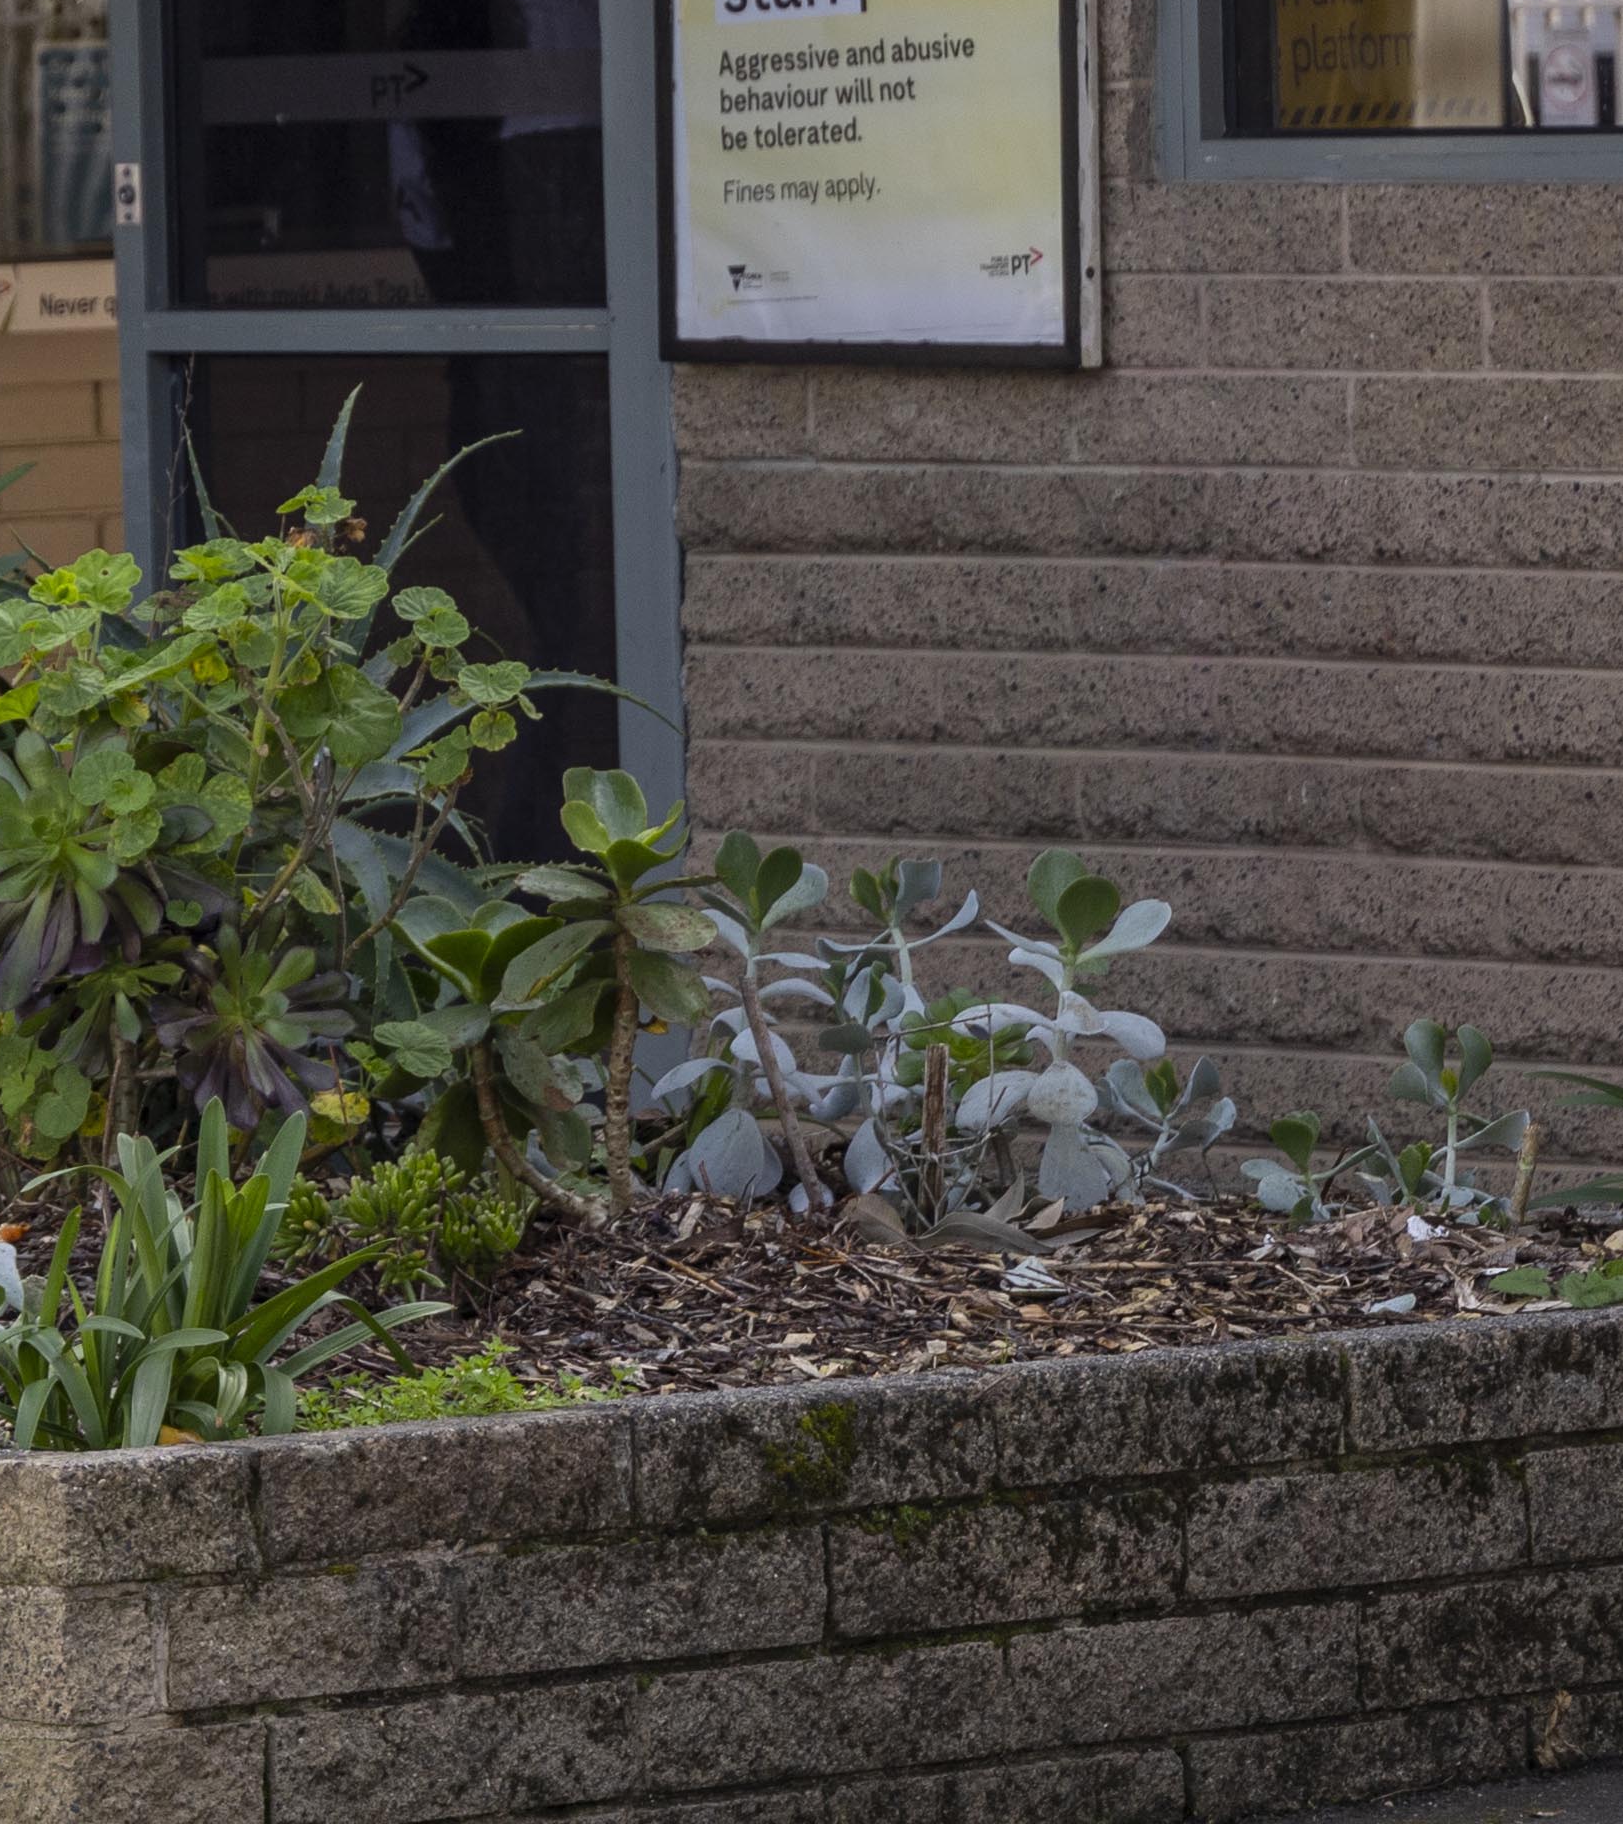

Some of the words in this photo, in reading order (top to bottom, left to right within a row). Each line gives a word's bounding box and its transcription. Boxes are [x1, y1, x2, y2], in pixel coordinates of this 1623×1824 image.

[719, 43, 840, 81] Aggressive
[846, 38, 886, 67] and
[891, 32, 976, 65] abusive
[720, 82, 829, 114] behaviour
[834, 77, 874, 106] will
[879, 75, 917, 102] not
[721, 125, 748, 152] be
[754, 116, 863, 150] tolerated.
[723, 178, 776, 205] Fines
[780, 179, 820, 206] may
[825, 171, 882, 202] apply.
[39, 291, 99, 319] Never
